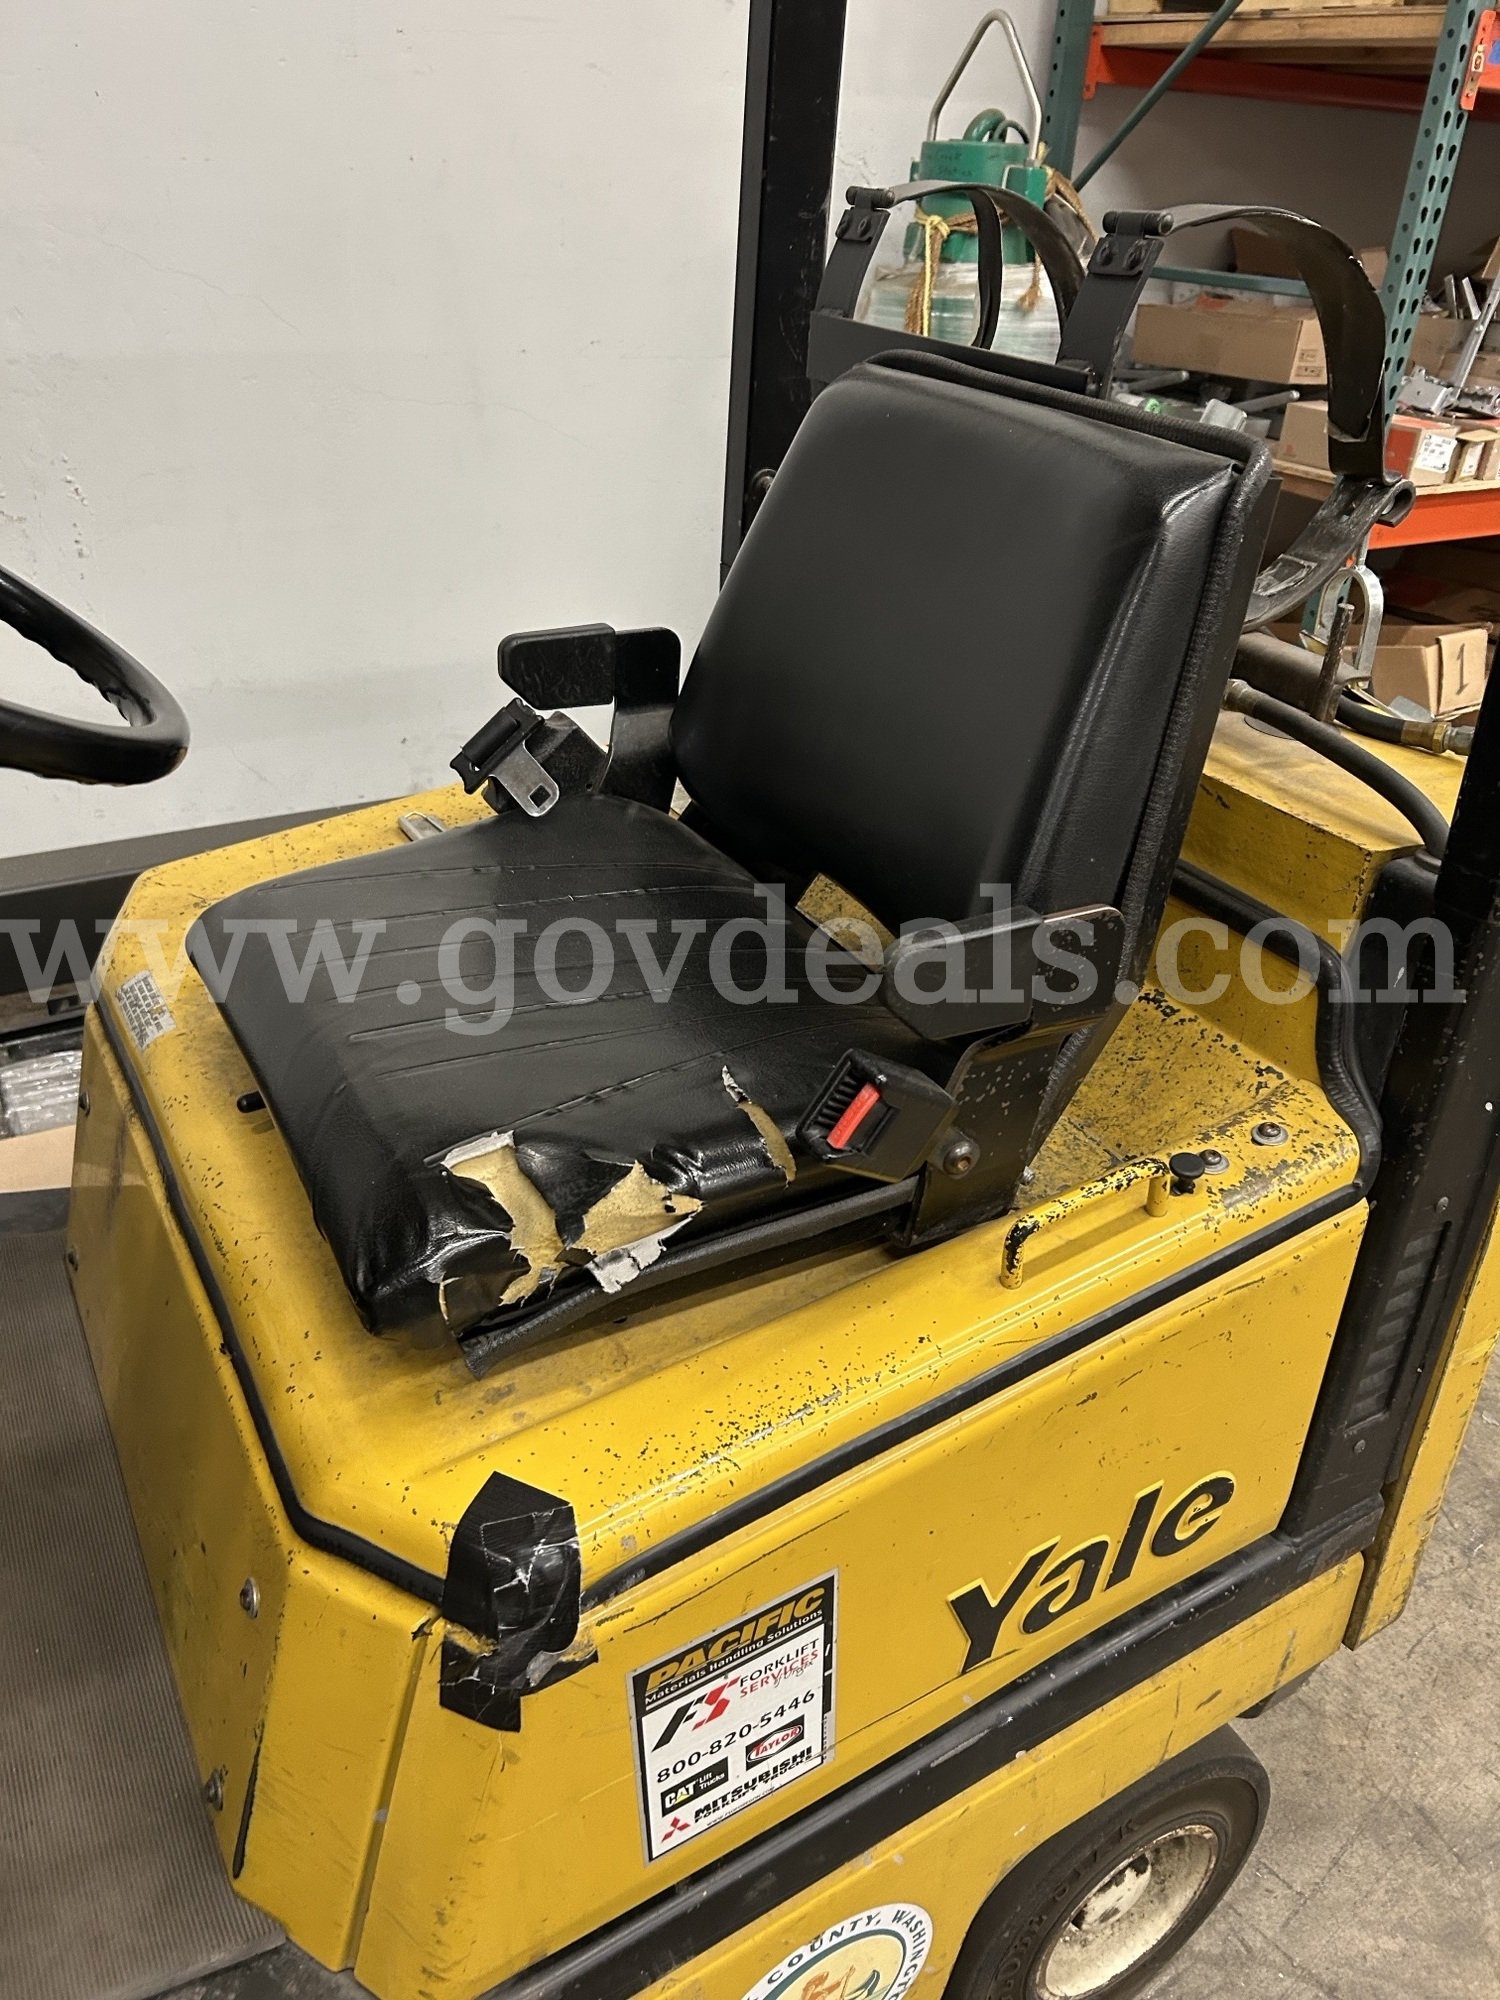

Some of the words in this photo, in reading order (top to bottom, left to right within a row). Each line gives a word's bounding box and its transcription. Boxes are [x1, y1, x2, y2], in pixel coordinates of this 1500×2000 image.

[1455, 643, 1468, 695] 1
[948, 1471, 1236, 1675] Yale
[645, 1668, 706, 1704] Materials
[709, 1640, 763, 1672] Handling
[767, 1609, 823, 1643] Solutions
[646, 1587, 825, 1690] PACIFIC
[740, 1638, 819, 1687] FORKLIFT
[740, 1649, 818, 1698] SERVICES
[657, 1689, 815, 1783] 800-820-5446
[664, 1780, 697, 1809] CAT
[694, 1746, 812, 1818] MITSUBISHI
[694, 1784, 759, 1824] FORKLIFT
[763, 1754, 813, 1784] TRUCKS
[699, 1772, 713, 1783] Lift
[699, 1772, 725, 1790] Trucks
[767, 1910, 881, 1984] COUNTY,
